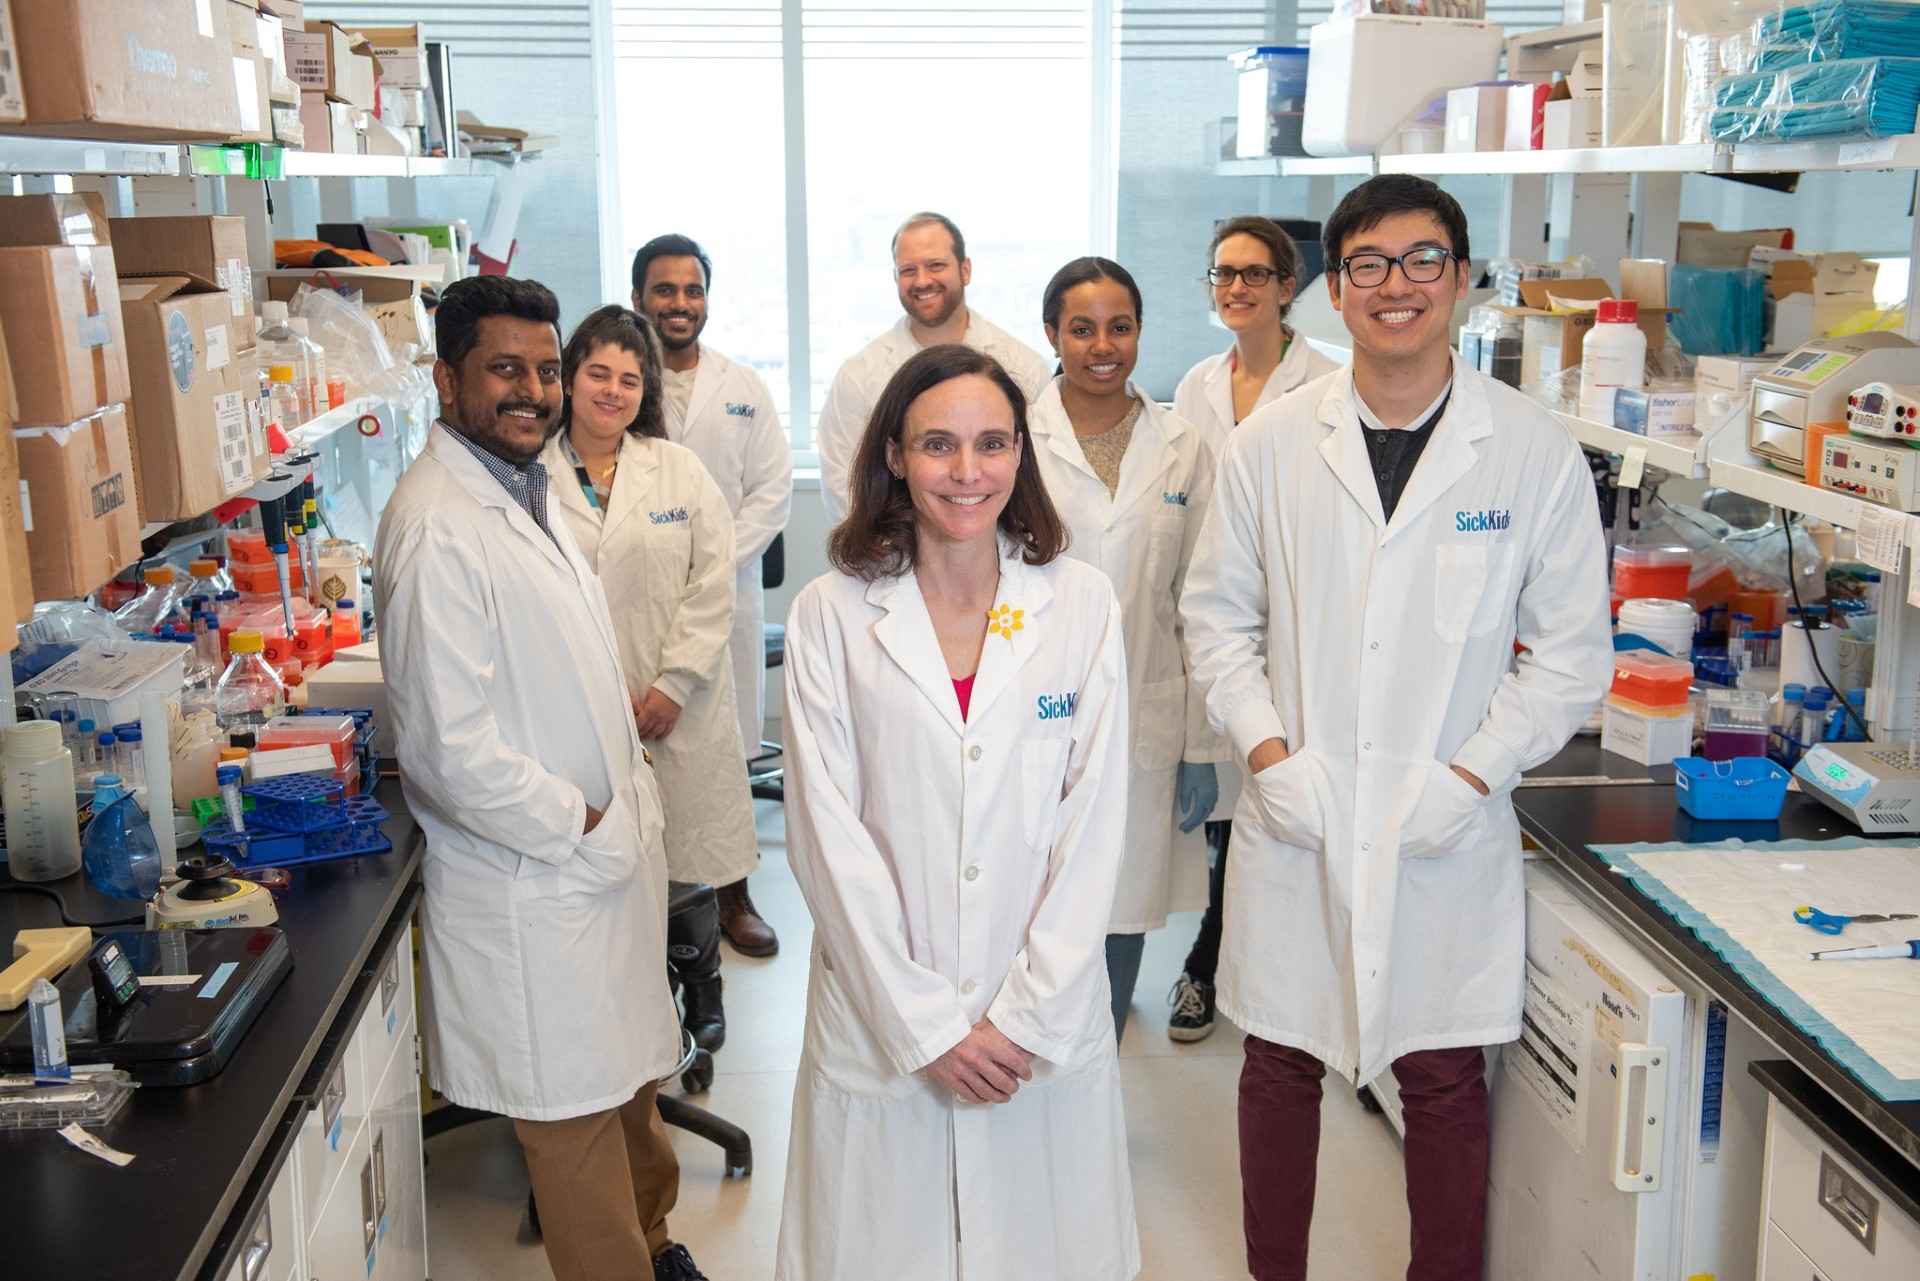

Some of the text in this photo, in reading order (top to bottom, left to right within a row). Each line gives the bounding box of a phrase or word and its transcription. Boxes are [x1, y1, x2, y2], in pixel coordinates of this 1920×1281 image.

[725, 402, 755, 419] SickKid
[649, 506, 688, 525] SickKids
[1038, 692, 1076, 720] SickK
